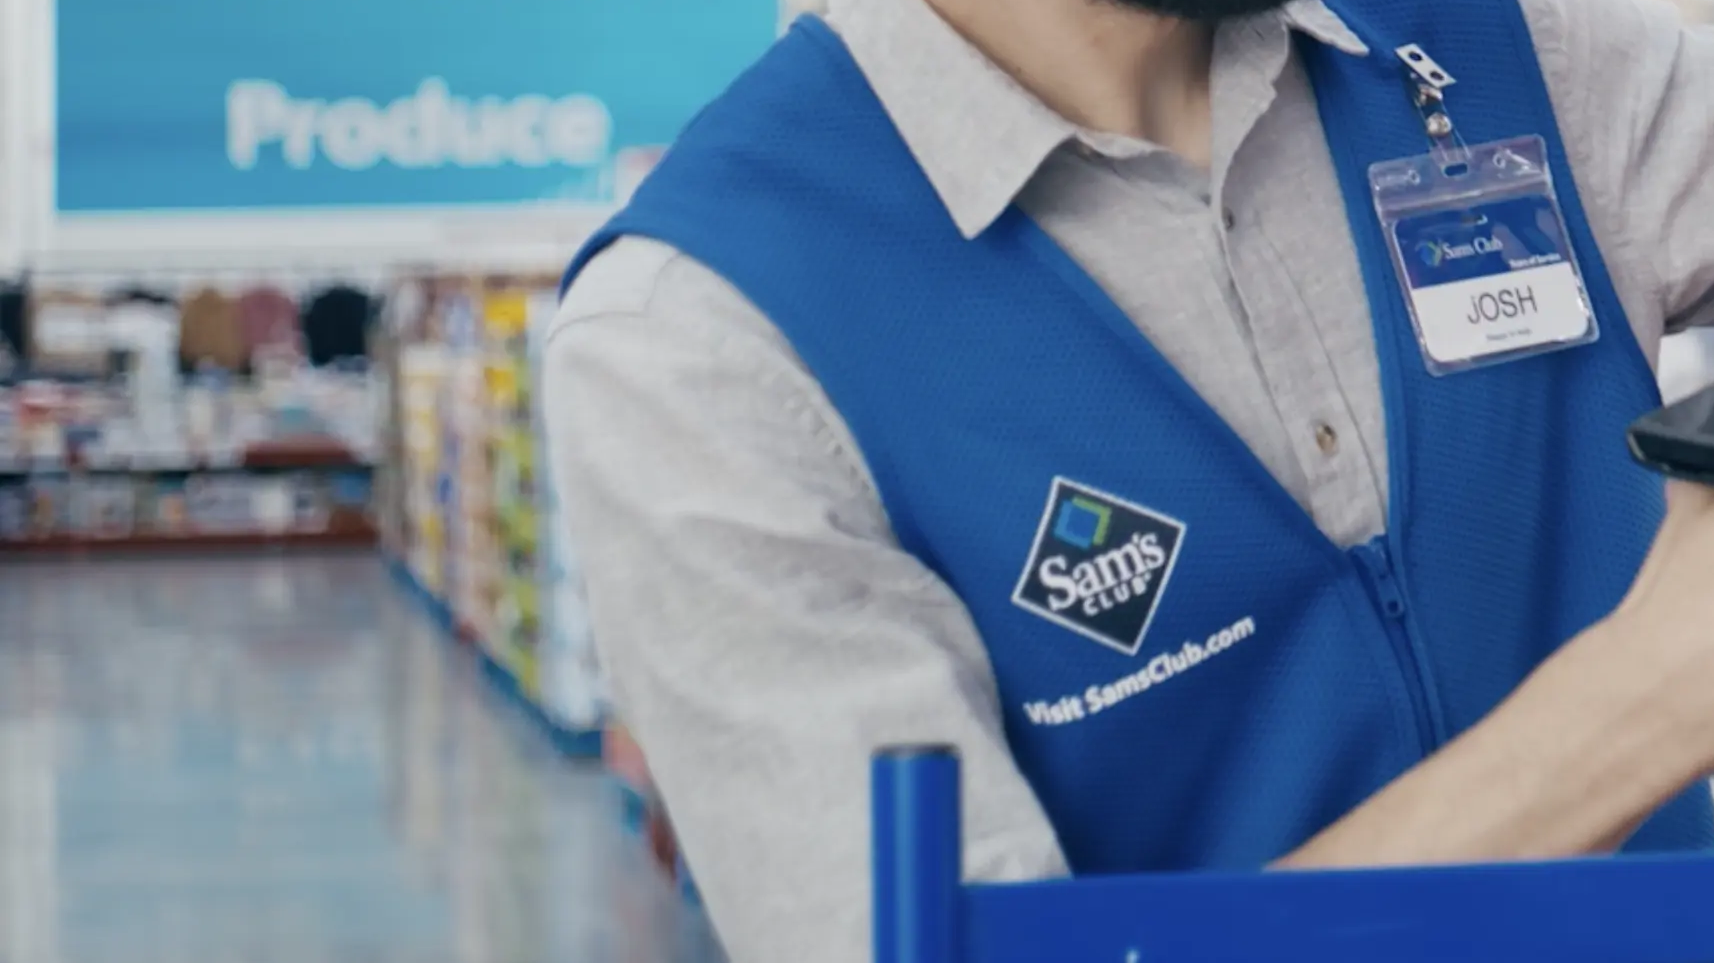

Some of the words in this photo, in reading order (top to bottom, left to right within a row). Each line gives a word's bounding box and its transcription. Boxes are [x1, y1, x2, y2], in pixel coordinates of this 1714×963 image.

[225, 76, 612, 170] Produce
[1467, 285, 1538, 325] JOSH
[1038, 532, 1166, 612] Sam's
[1083, 577, 1148, 617] CLUB
[1023, 696, 1084, 725] Visit
[1085, 615, 1256, 714] SamsClub.com
